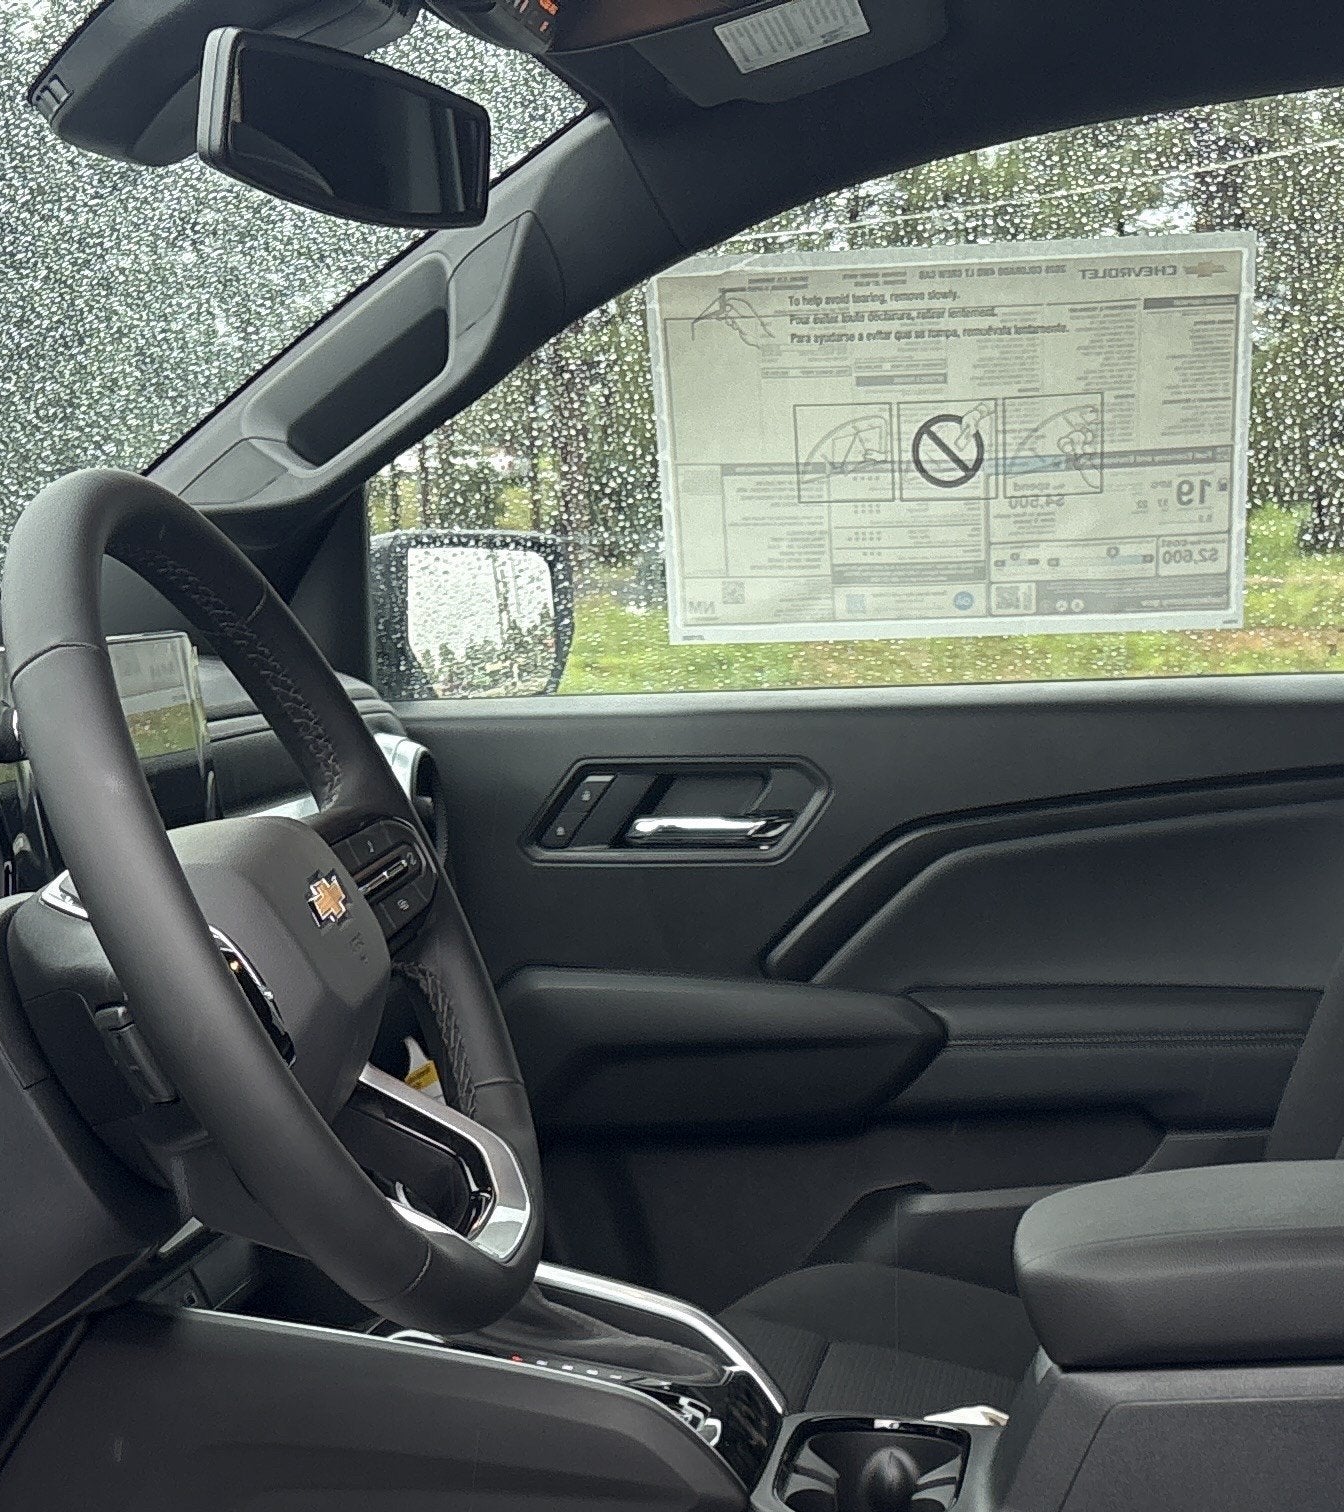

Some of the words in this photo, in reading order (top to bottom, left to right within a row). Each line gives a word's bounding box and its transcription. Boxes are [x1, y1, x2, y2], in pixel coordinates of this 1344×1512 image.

[788, 295, 801, 307] To
[802, 294, 823, 307] help
[824, 293, 850, 305] avoid
[890, 291, 925, 301] remove
[790, 333, 811, 343] Para
